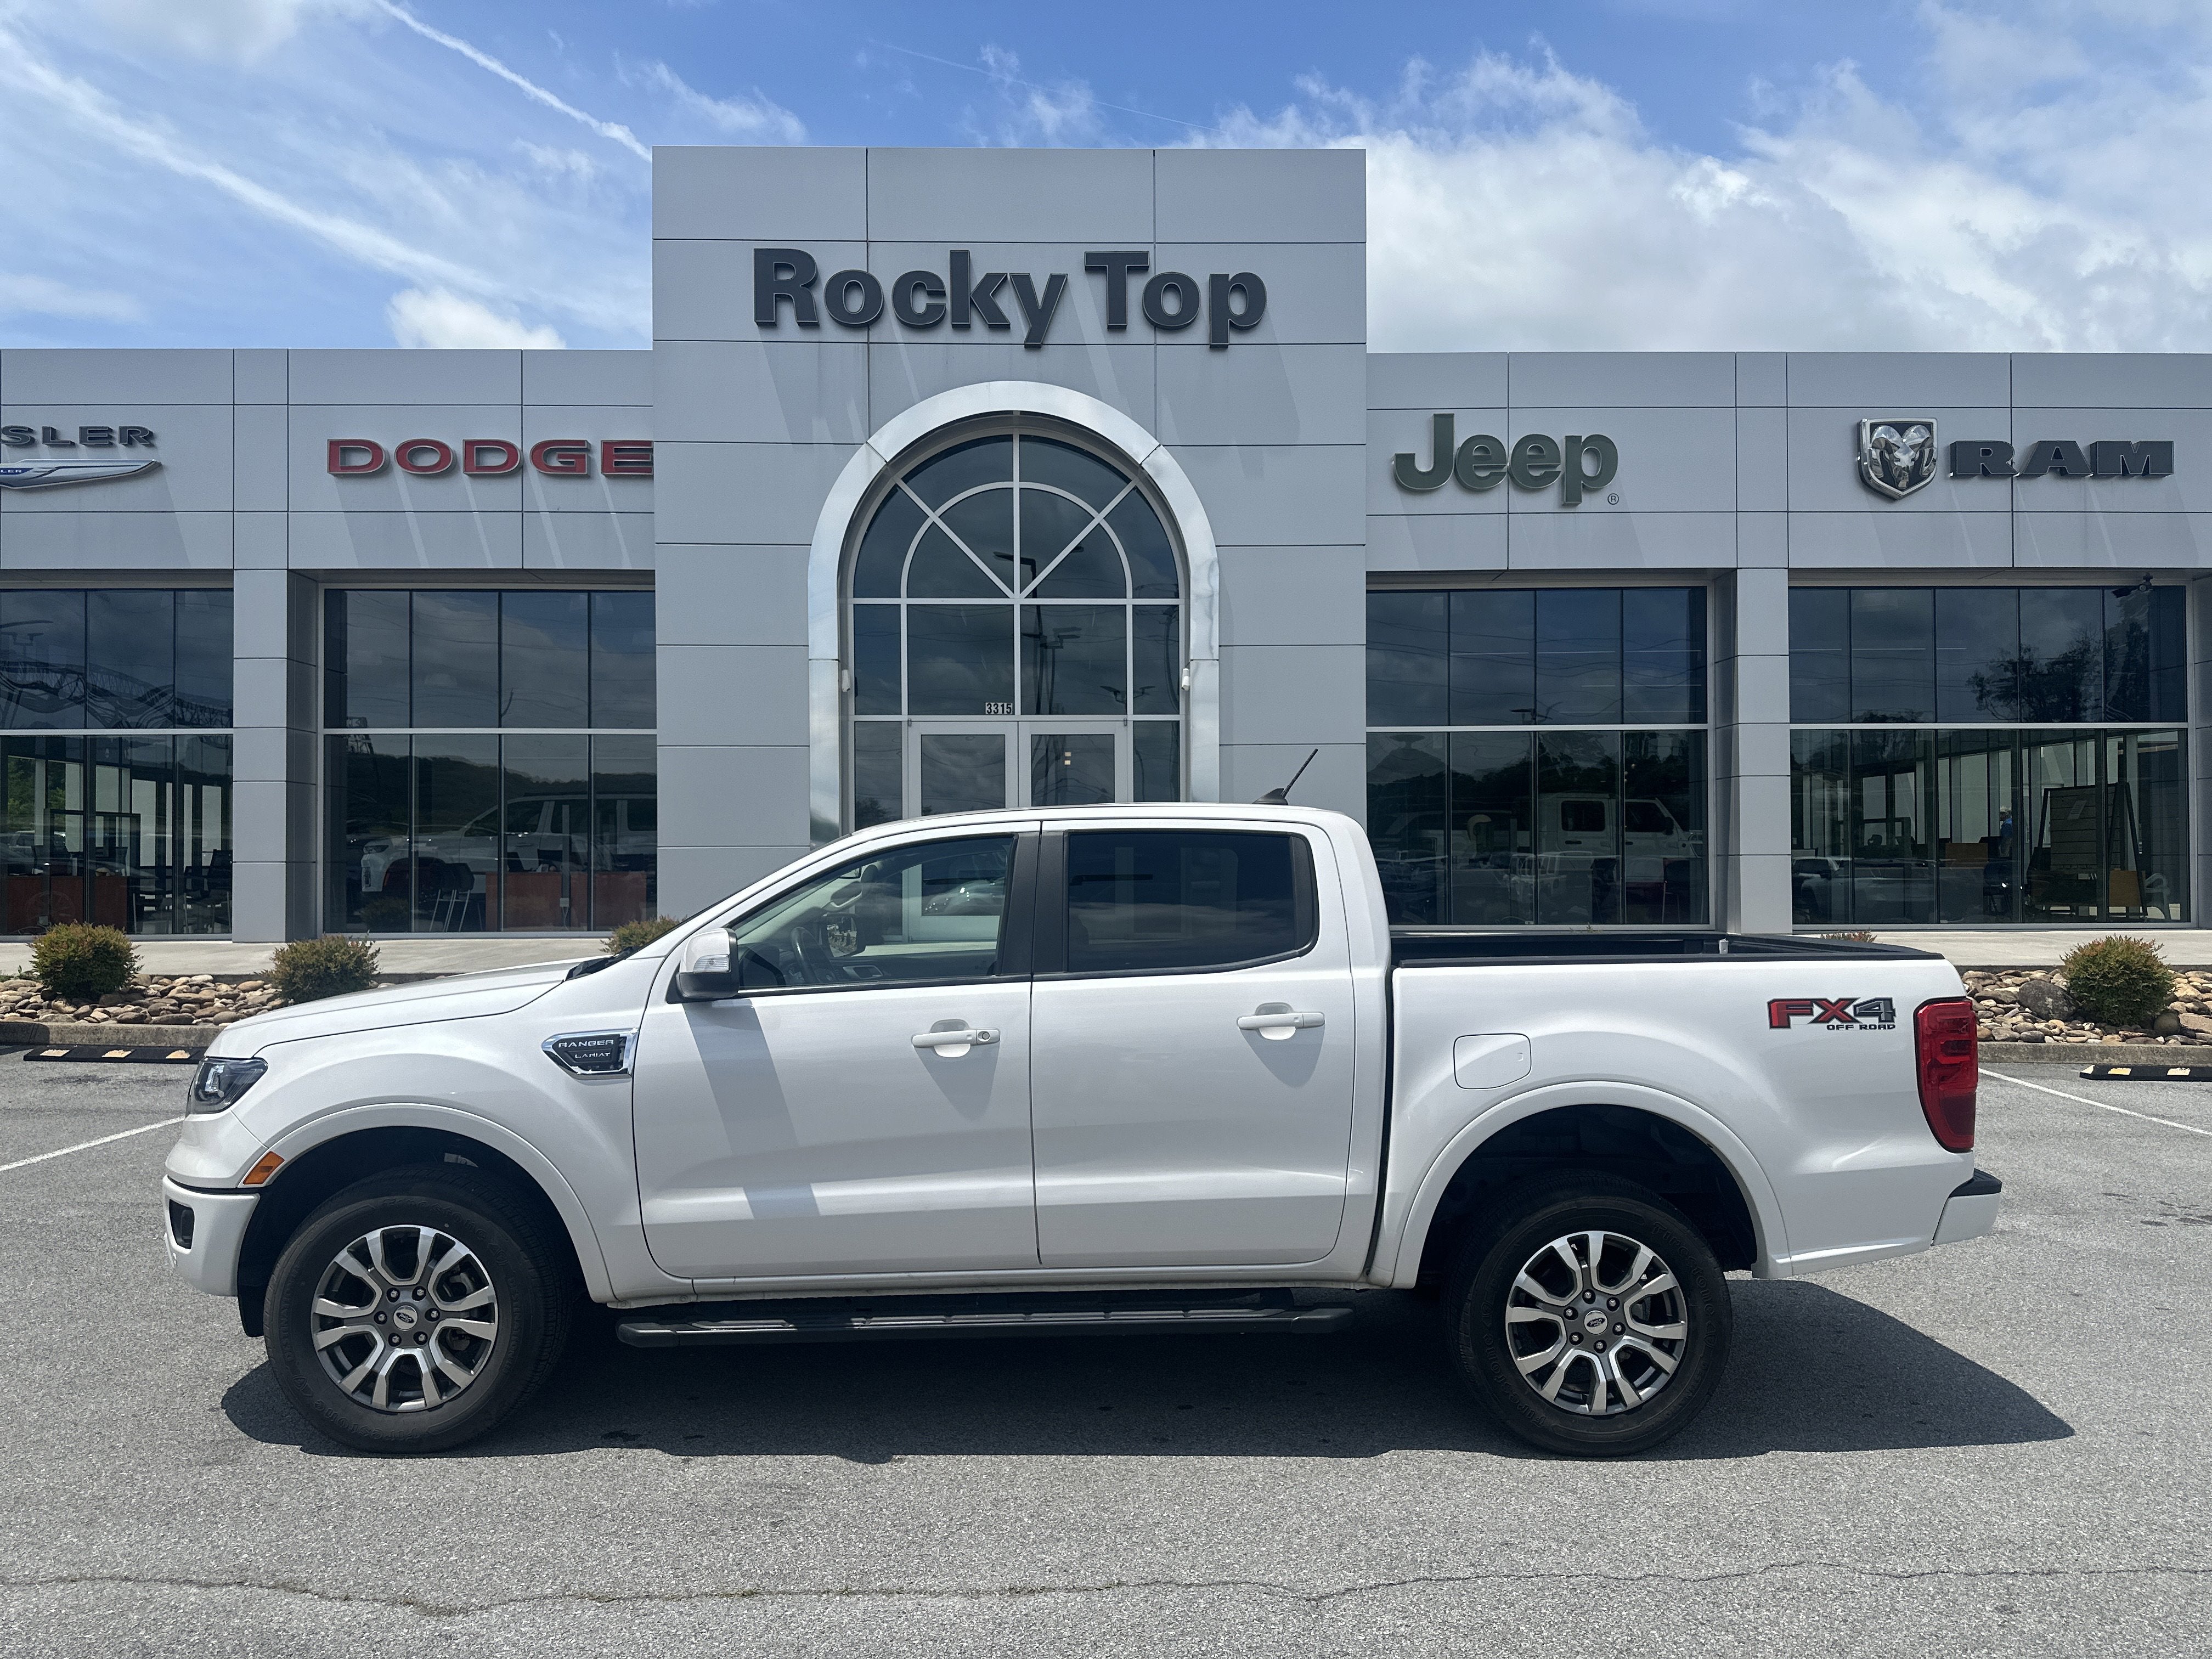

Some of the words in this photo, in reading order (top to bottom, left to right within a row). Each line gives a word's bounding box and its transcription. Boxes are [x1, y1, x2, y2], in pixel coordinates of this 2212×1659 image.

[753, 248, 1068, 348] Rocky
[1084, 251, 1267, 349] Top
[327, 438, 654, 478] DODGE
[1393, 413, 1618, 506] Jeep
[1950, 439, 2175, 477] RAM
[986, 703, 1012, 714] 3315
[1767, 997, 1897, 1029] FX4
[558, 1039, 614, 1048] RANGER
[1652, 1221, 1716, 1316] Firestone
[1482, 1334, 1547, 1428] Firestone
